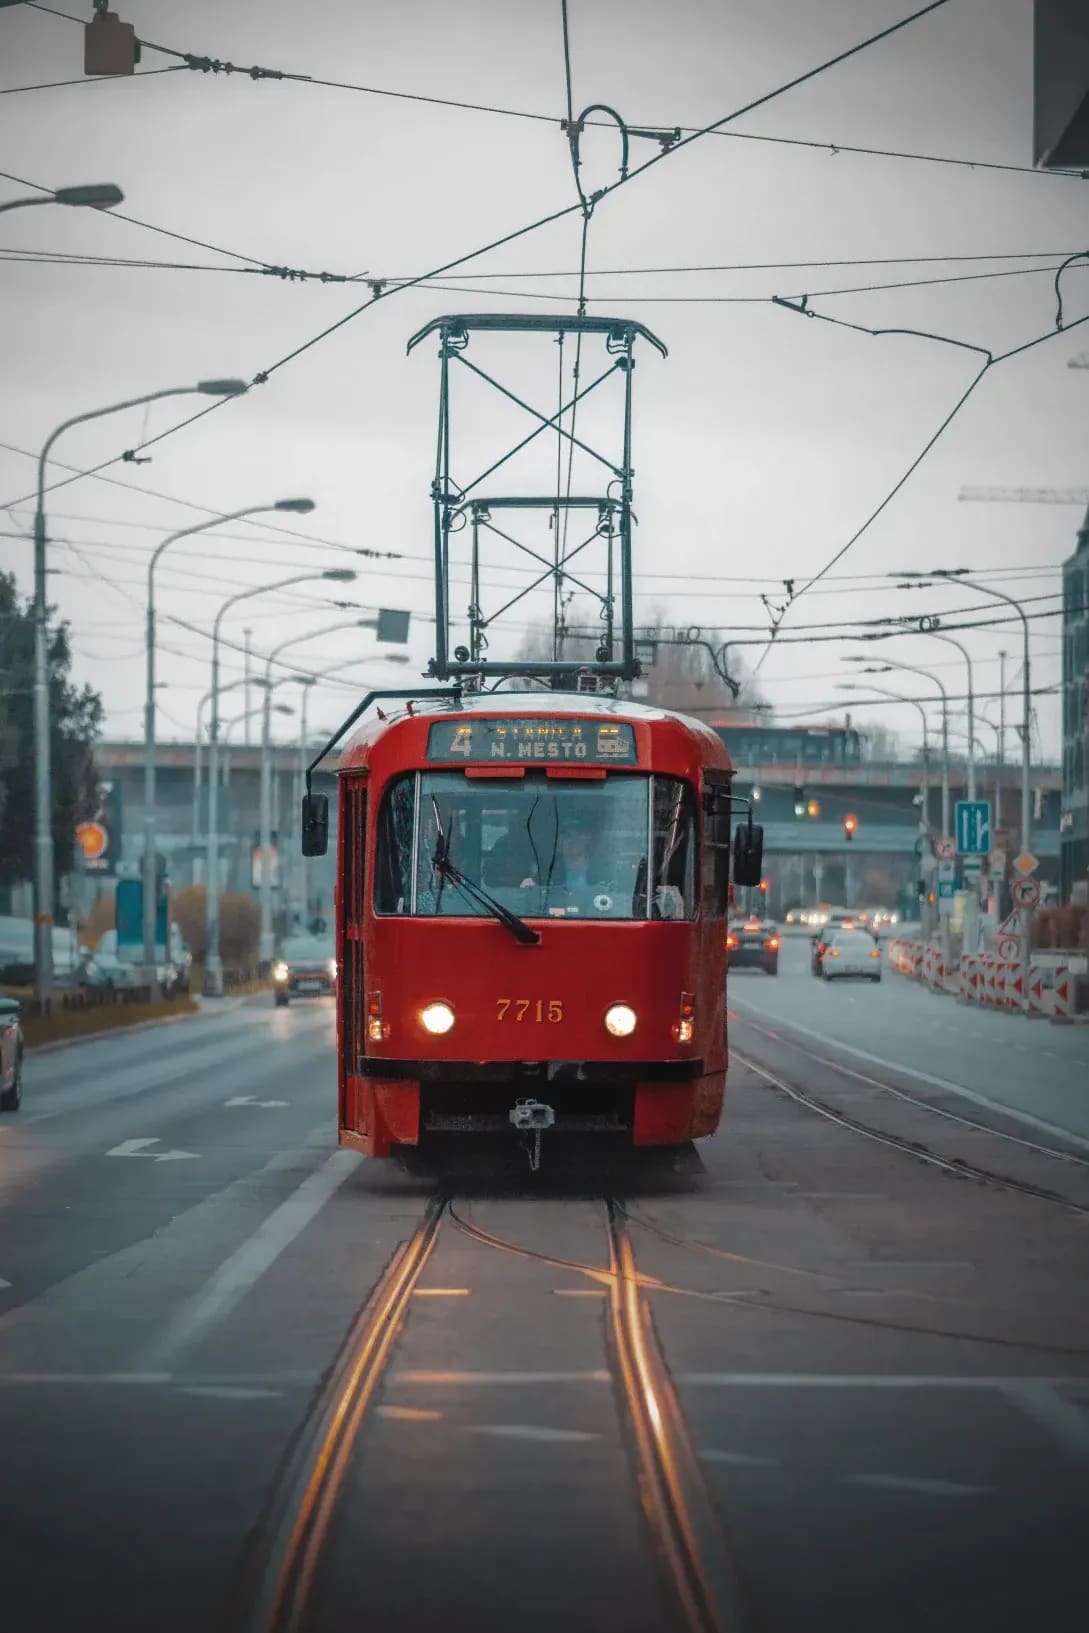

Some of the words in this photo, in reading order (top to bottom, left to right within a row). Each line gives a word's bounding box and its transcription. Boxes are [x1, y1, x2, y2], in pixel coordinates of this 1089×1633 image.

[449, 727, 473, 757] 4
[490, 742, 512, 757] N.
[518, 742, 587, 757] MESTO
[496, 998, 563, 1022] 7715
